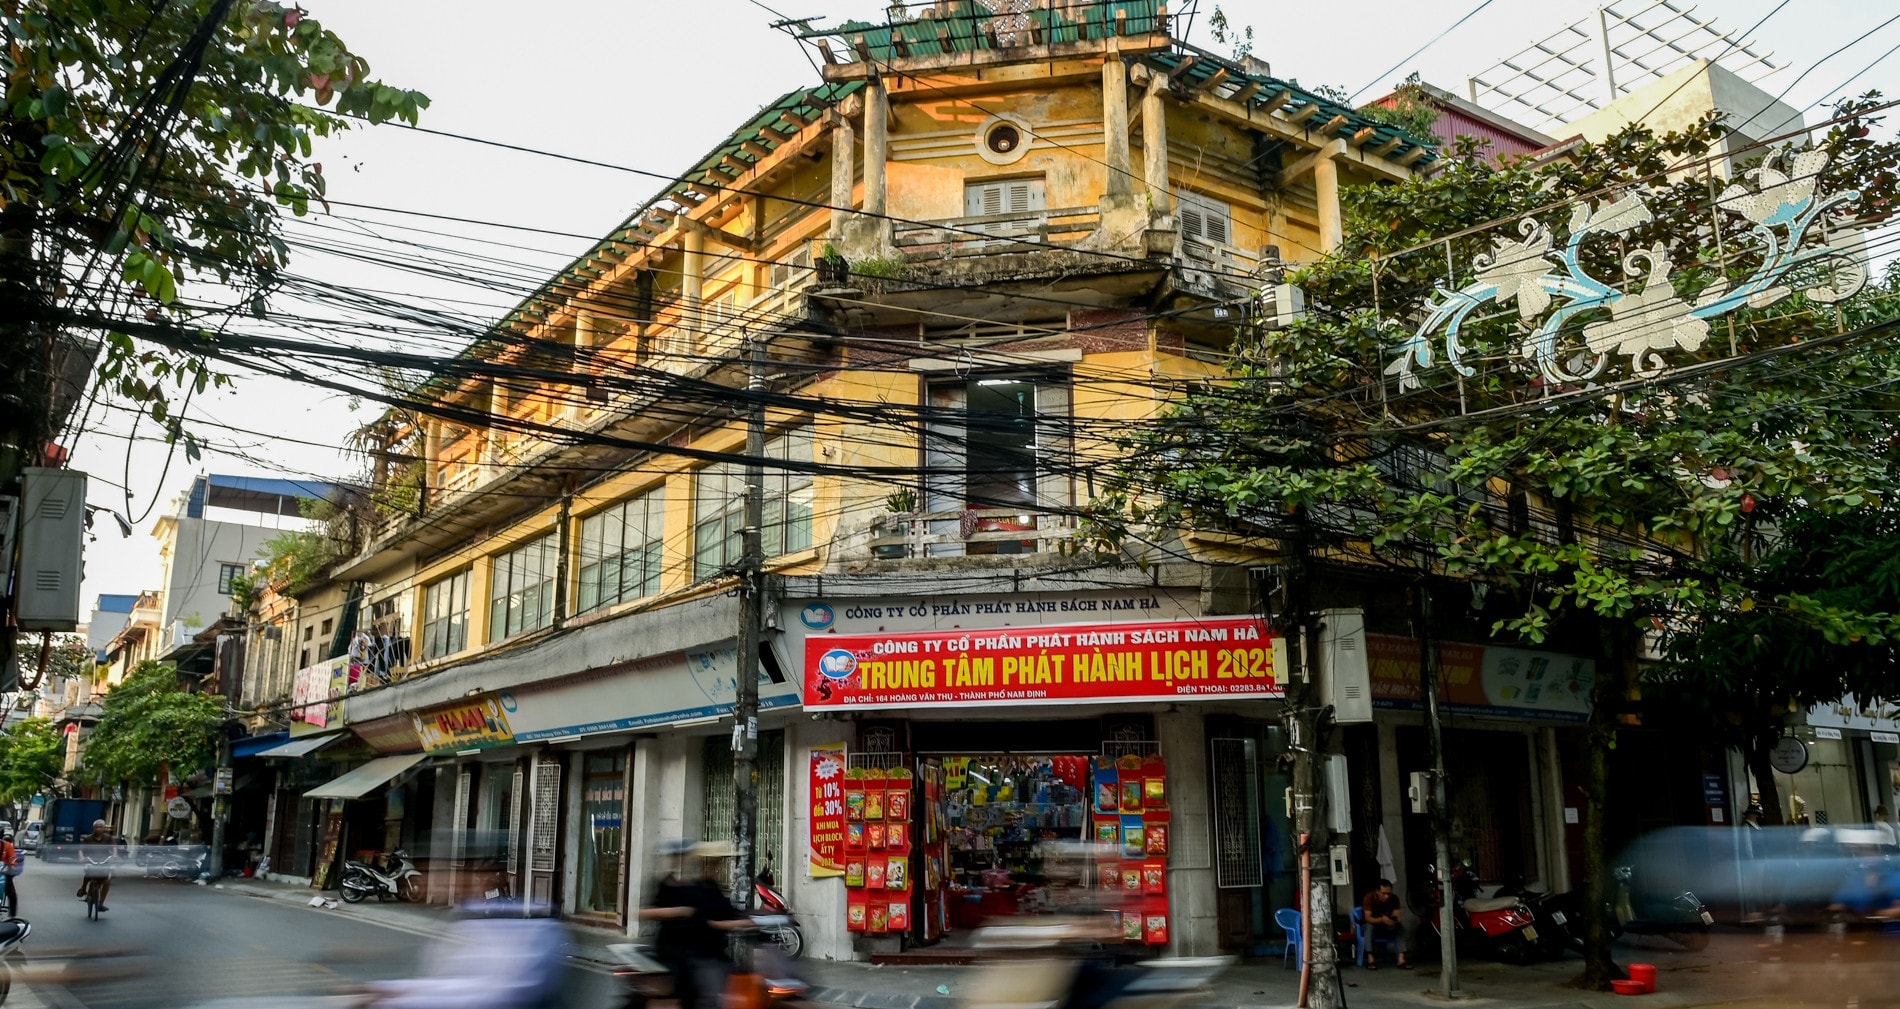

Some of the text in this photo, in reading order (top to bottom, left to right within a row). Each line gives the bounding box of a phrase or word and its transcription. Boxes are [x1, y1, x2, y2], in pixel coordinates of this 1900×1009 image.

[845, 595, 1160, 619] CÔNG TY CỔ PHẦN PHÁT HÀNH SÁCH NAM HÀ
[873, 625, 1259, 655] CÔNG TY CỔ PHẦN PHÁT HÀNH SÁCH NAM HÀ
[859, 660, 936, 690] TRUNG
[942, 653, 994, 687] TÂM
[1002, 649, 1065, 685] PHÁT
[1072, 647, 1142, 683] HÀNH
[1151, 650, 1209, 687] LỊCH
[876, 694, 888, 703] 164
[889, 692, 917, 702] HOÀNG
[919, 691, 936, 702] VĂN
[959, 689, 986, 699] THÀNH
[988, 688, 1005, 699] PHỐ
[1007, 690, 1025, 699] NAM
[1027, 689, 1046, 699] ĐỊNH
[1177, 684, 1197, 694] ĐIỆN
[823, 781, 840, 798] 10%
[824, 799, 843, 816] 30%
[826, 820, 839, 829] MUA
[825, 832, 843, 842] BLOCK
